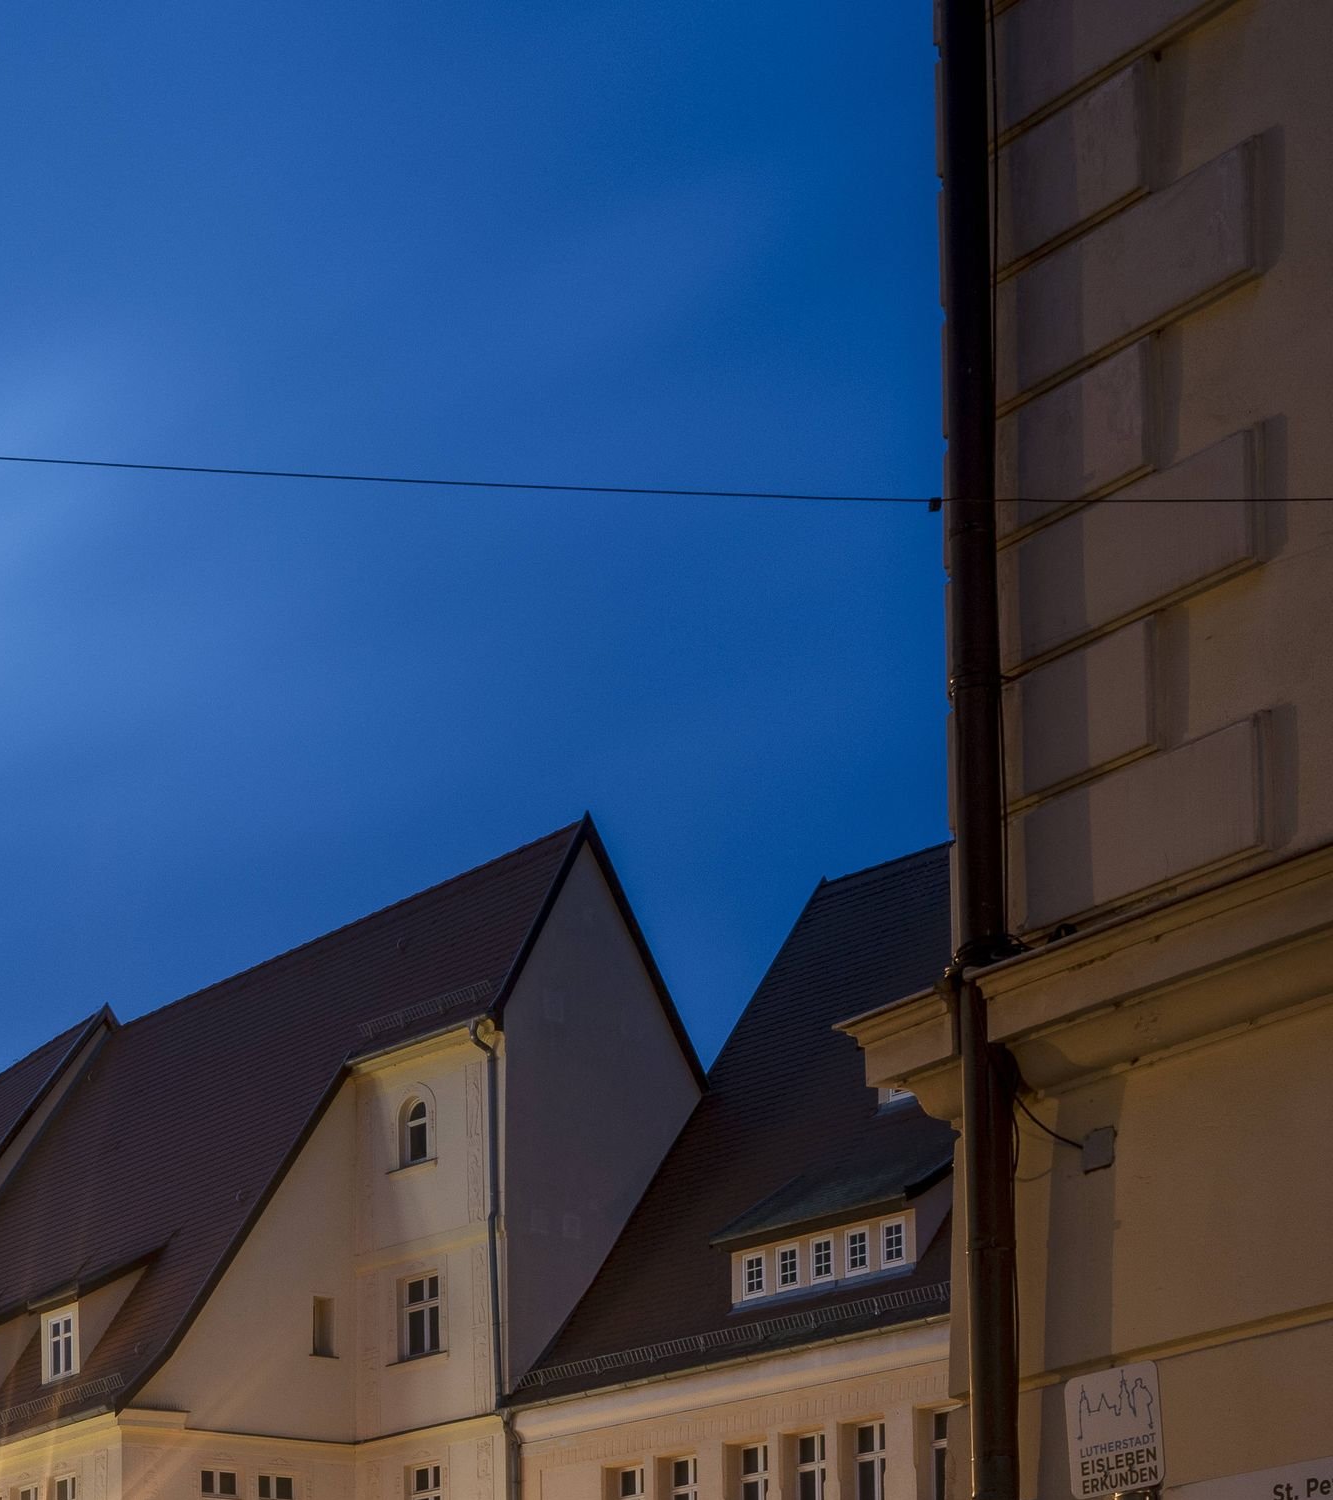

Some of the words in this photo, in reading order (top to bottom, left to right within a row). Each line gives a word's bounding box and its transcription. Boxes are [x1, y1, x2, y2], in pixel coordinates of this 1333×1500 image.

[1080, 1432, 1156, 1459] LUTHERSTADT
[1081, 1446, 1157, 1476] EISLEBEN
[1083, 1465, 1158, 1494] ERKUNDEN
[1306, 1478, 1333, 1498] Pe
